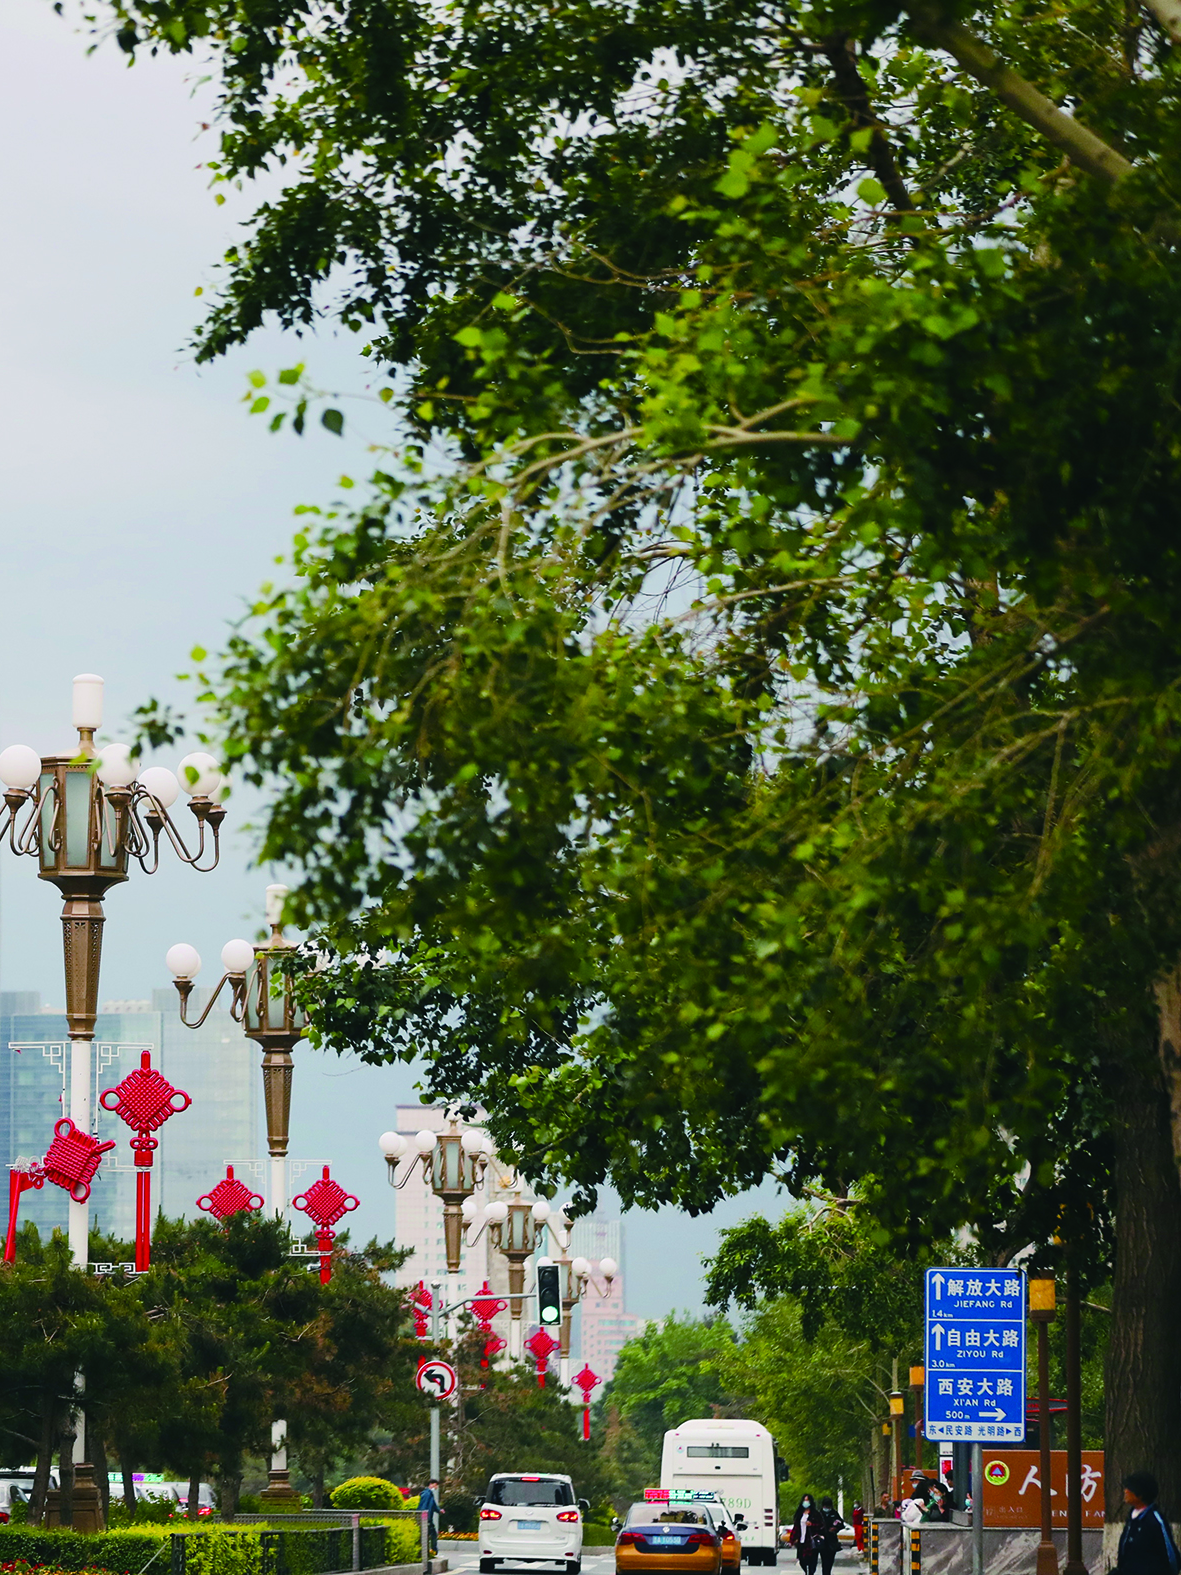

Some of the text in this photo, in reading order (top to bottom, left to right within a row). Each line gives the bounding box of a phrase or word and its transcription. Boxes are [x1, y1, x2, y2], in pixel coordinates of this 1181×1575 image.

[947, 1278, 1021, 1297] 解放大路
[954, 1300, 1013, 1308] JIEFANG Rd
[947, 1328, 1019, 1347] 自由大路
[957, 1350, 1004, 1358] ZIYOU Rd
[937, 1378, 1014, 1396] 西安大路
[953, 1398, 997, 1407] XI'AN Rd
[928, 1424, 937, 1435] 东
[945, 1425, 973, 1436] 民安路
[978, 1426, 1005, 1437] 光明路
[1014, 1426, 1022, 1437] 西
[1018, 1464, 1102, 1503] 人防
